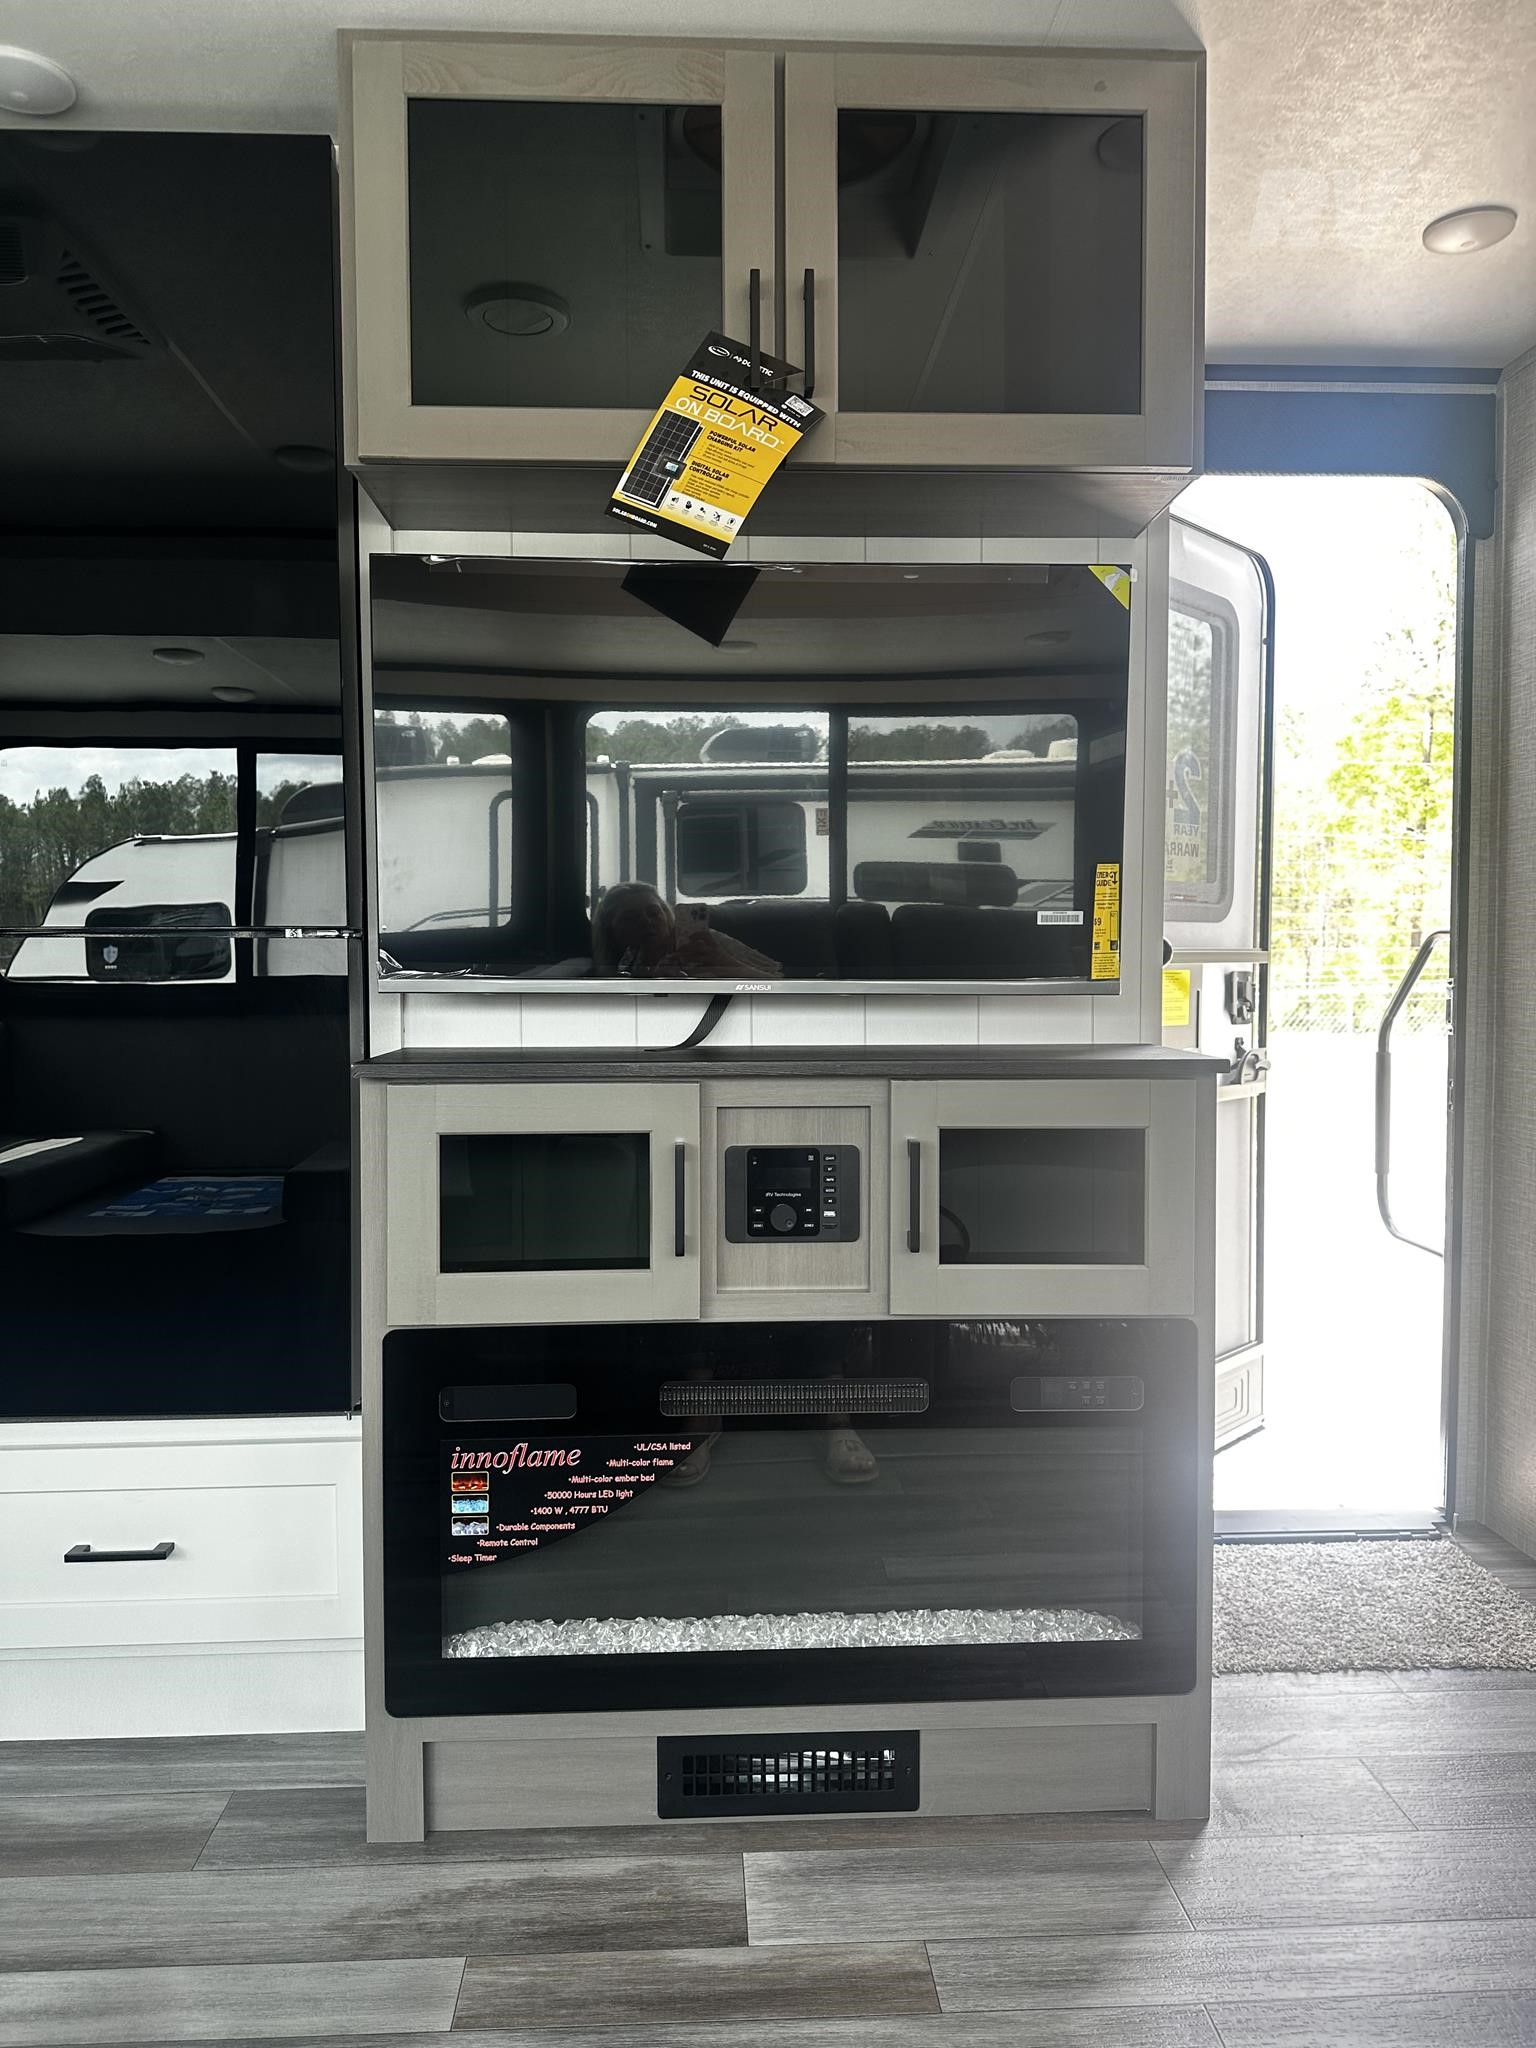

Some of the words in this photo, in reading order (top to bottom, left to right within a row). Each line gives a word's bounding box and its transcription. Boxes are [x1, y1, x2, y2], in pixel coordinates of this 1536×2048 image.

[691, 369, 710, 382] THIS
[710, 377, 730, 390] UNIT
[730, 386, 738, 394] IS
[738, 389, 778, 414] EQUIPPED
[779, 411, 801, 428] WITH
[690, 386, 778, 432] SOLAR
[674, 397, 698, 417] ON
[704, 410, 780, 448] BOARD
[706, 435, 734, 450] CHARGING
[734, 445, 744, 453] KIT
[709, 430, 738, 445] POWERFUL
[738, 442, 756, 452] SOLAR
[688, 466, 722, 482] CONTROLLER
[691, 460, 712, 472] DIGITAL
[712, 468, 730, 478] SOLAR
[636, 1443, 668, 1451] UL/CSA
[669, 1442, 691, 1451] listed
[451, 1443, 582, 1474] innoflame
[608, 1459, 651, 1468] Multi-color
[652, 1458, 674, 1467] flame
[571, 1474, 614, 1483] Multi-color
[615, 1474, 639, 1482] ember
[640, 1474, 655, 1482] bed
[547, 1491, 572, 1499] 50000
[574, 1490, 597, 1499] Hours
[599, 1490, 614, 1498] LED
[616, 1490, 633, 1499] light
[533, 1507, 552, 1515] 1400
[554, 1506, 563, 1514] W
[591, 1506, 608, 1514] BTU
[499, 1523, 529, 1531] Durable
[531, 1522, 576, 1532] Components
[479, 1539, 509, 1547] Remote
[510, 1538, 538, 1547] Control
[451, 1554, 473, 1564] Sleep
[474, 1554, 497, 1562] Timer
